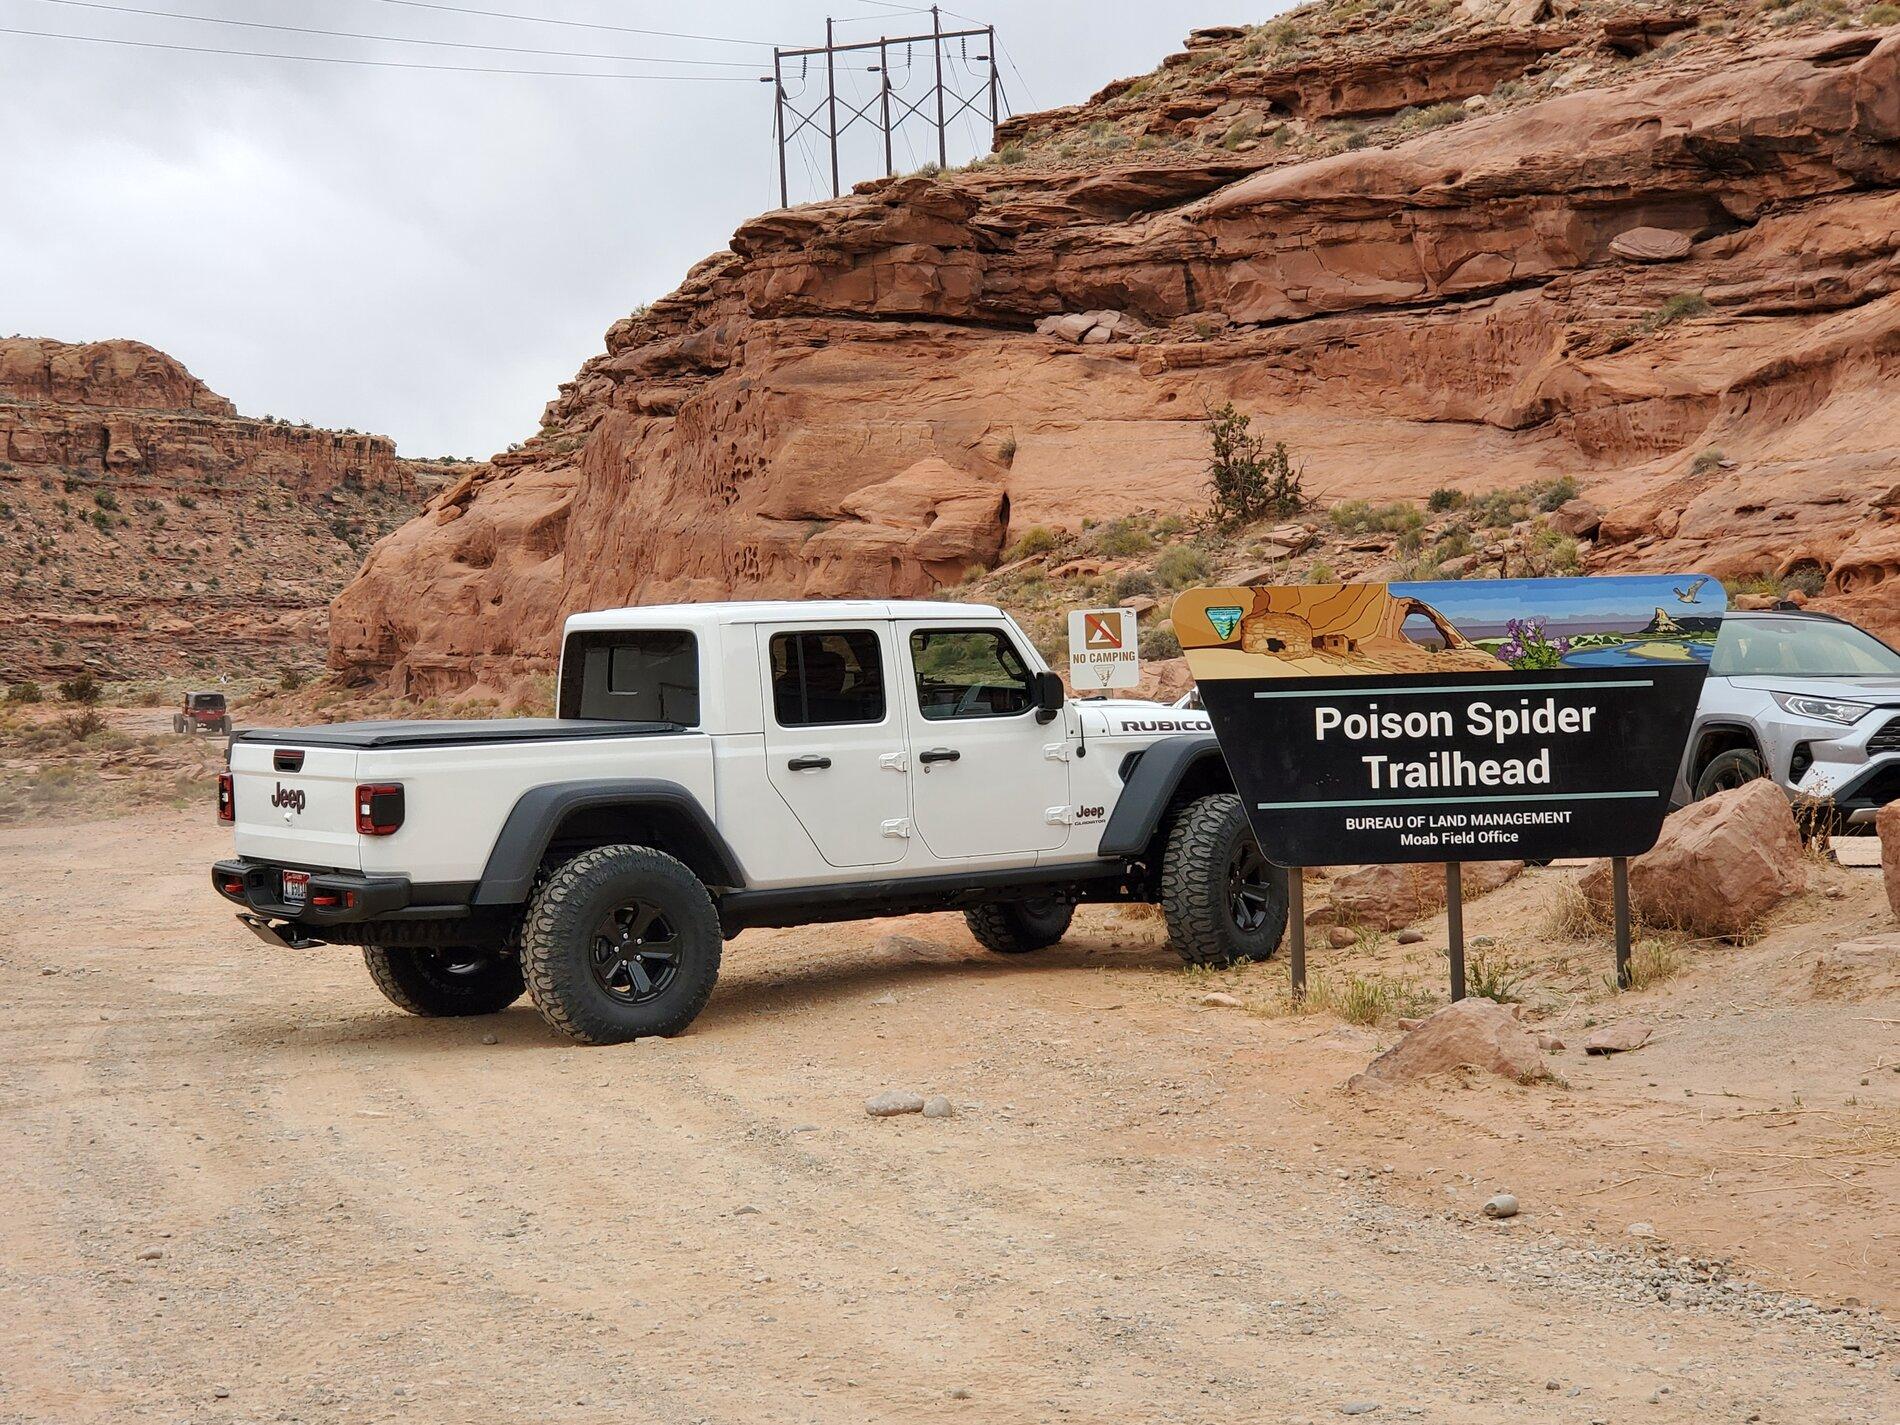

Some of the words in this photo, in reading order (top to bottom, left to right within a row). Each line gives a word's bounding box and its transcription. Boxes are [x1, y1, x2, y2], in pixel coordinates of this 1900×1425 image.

[1073, 654, 1087, 664] NO
[1090, 651, 1136, 663] CAMPING
[1120, 720, 1212, 732] RUBICO
[1315, 703, 1453, 741] Poison
[1466, 698, 1597, 743] Spider
[1361, 748, 1550, 789] Trailhead
[271, 781, 306, 815] Jeep
[1076, 805, 1105, 818] Jeep
[1345, 817, 1404, 830] BUREAU
[1406, 816, 1426, 828] OF
[1429, 814, 1468, 828] LAND
[1470, 811, 1573, 826] MANAGEMENT
[1400, 832, 1439, 846] Moab
[1441, 831, 1475, 844] Field
[1477, 830, 1519, 844] Office
